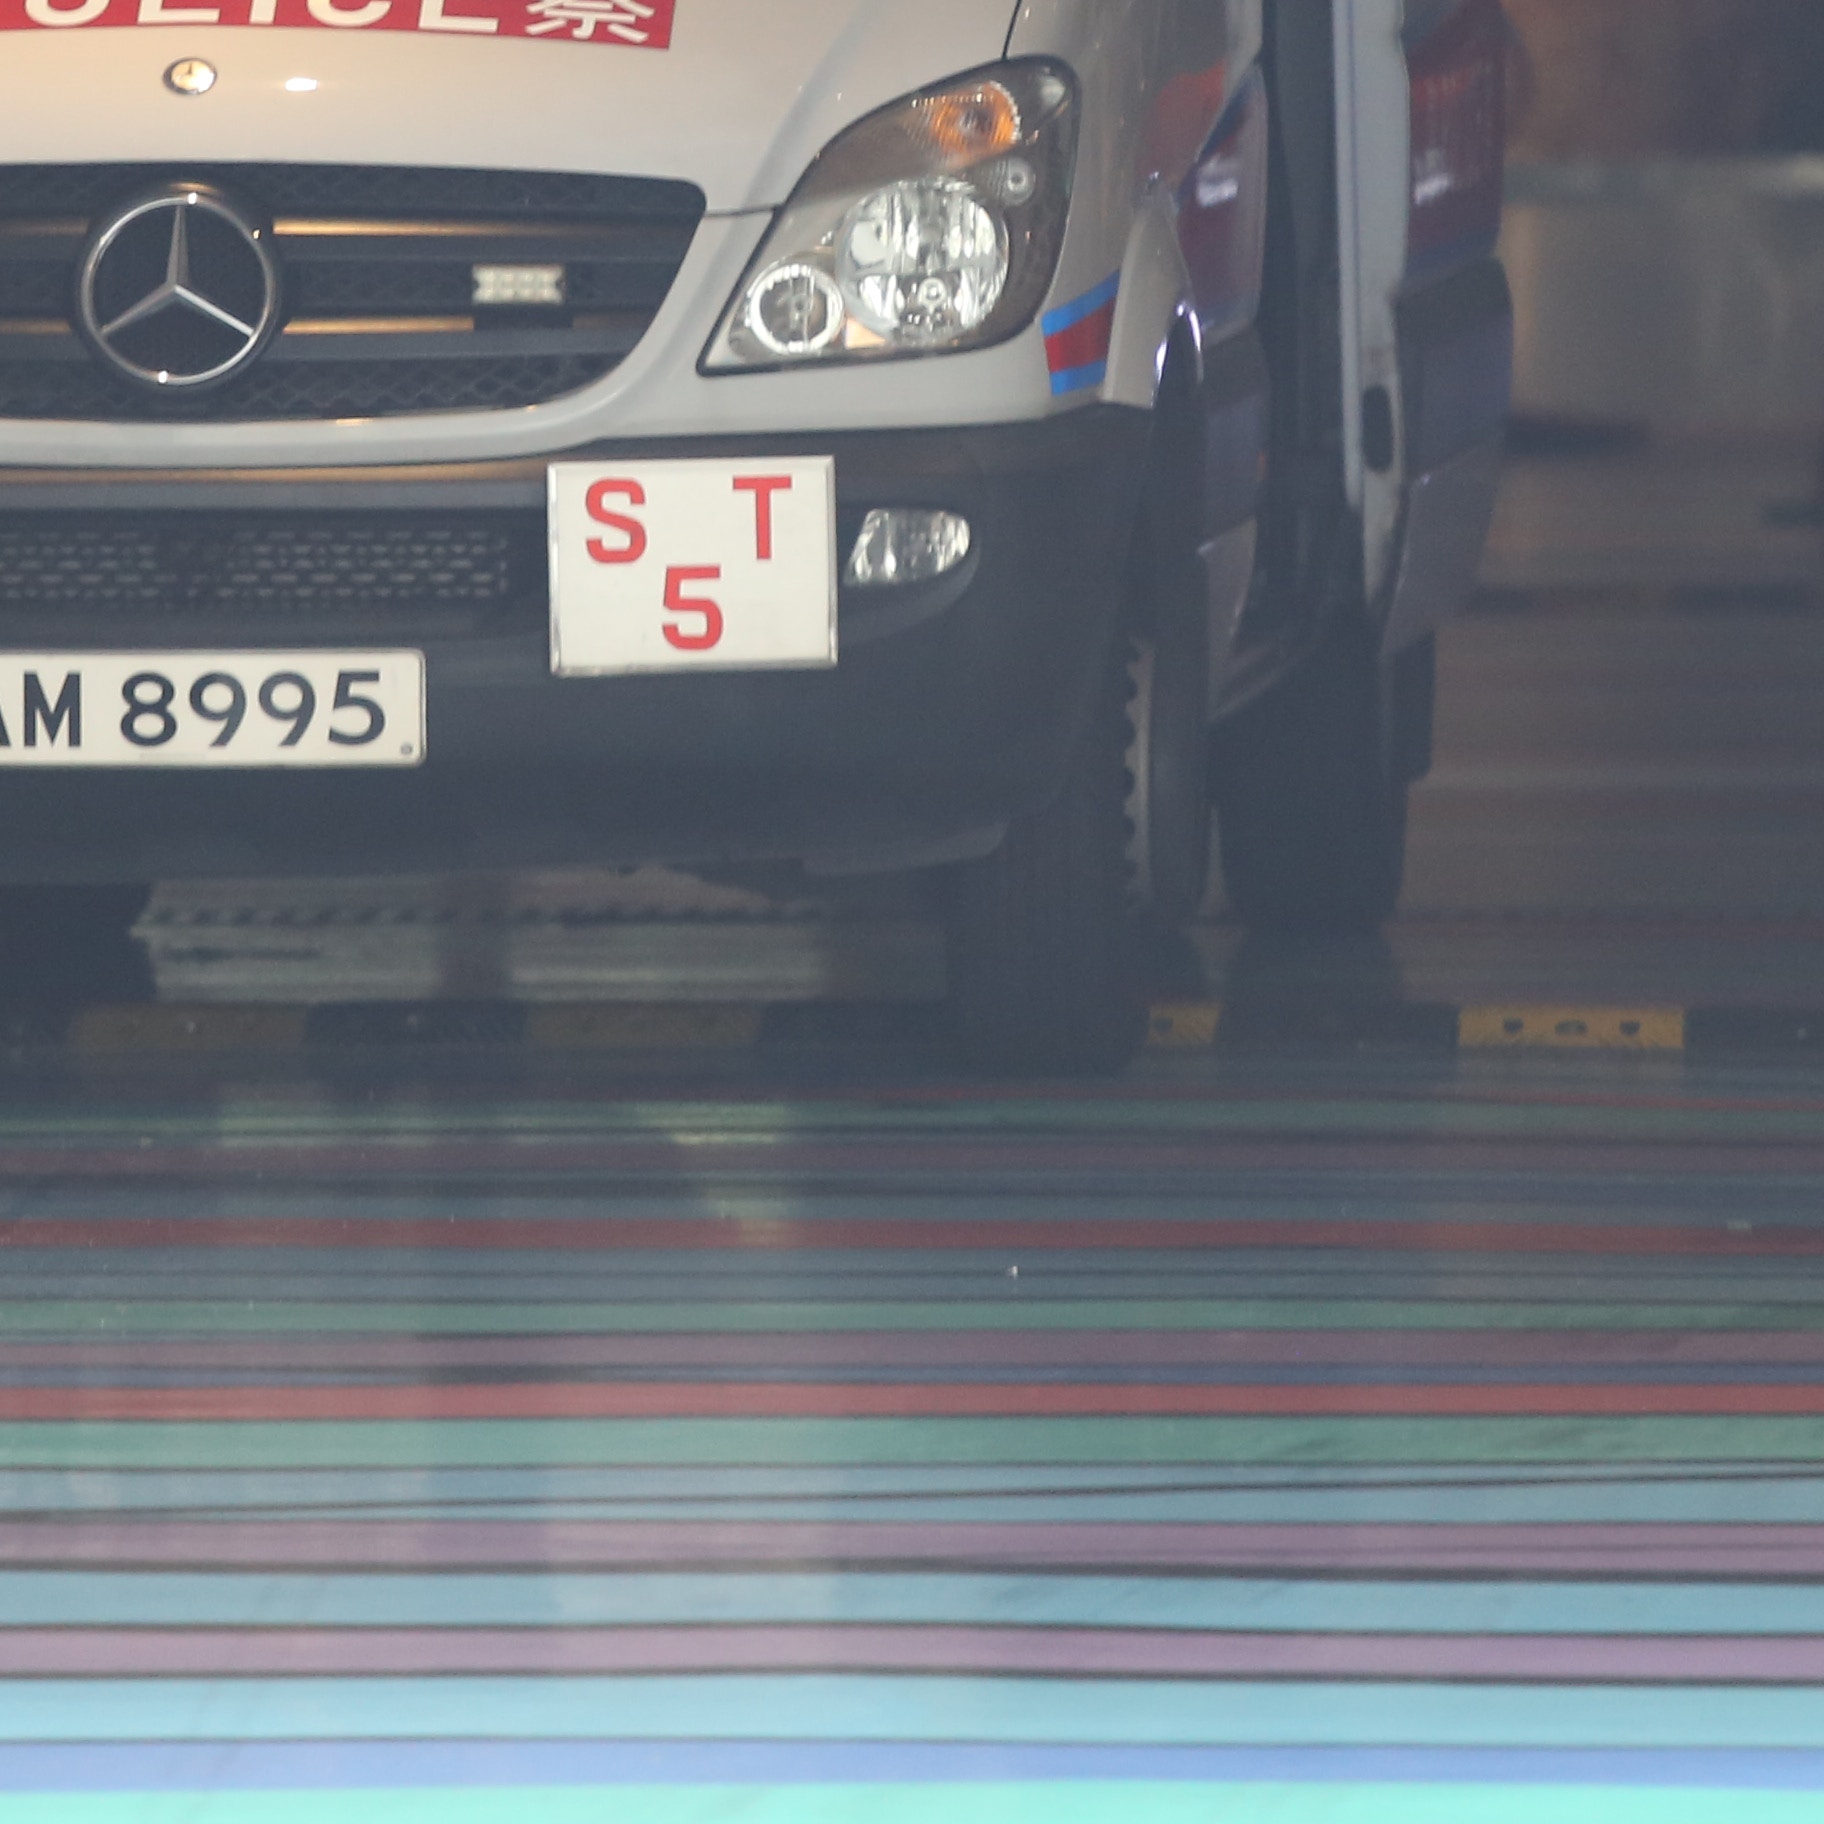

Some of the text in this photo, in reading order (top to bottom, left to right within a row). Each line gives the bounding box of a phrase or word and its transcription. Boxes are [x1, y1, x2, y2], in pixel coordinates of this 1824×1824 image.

[585, 475, 792, 564] S T
[662, 566, 724, 651] 5
[118, 671, 386, 748] 8995
